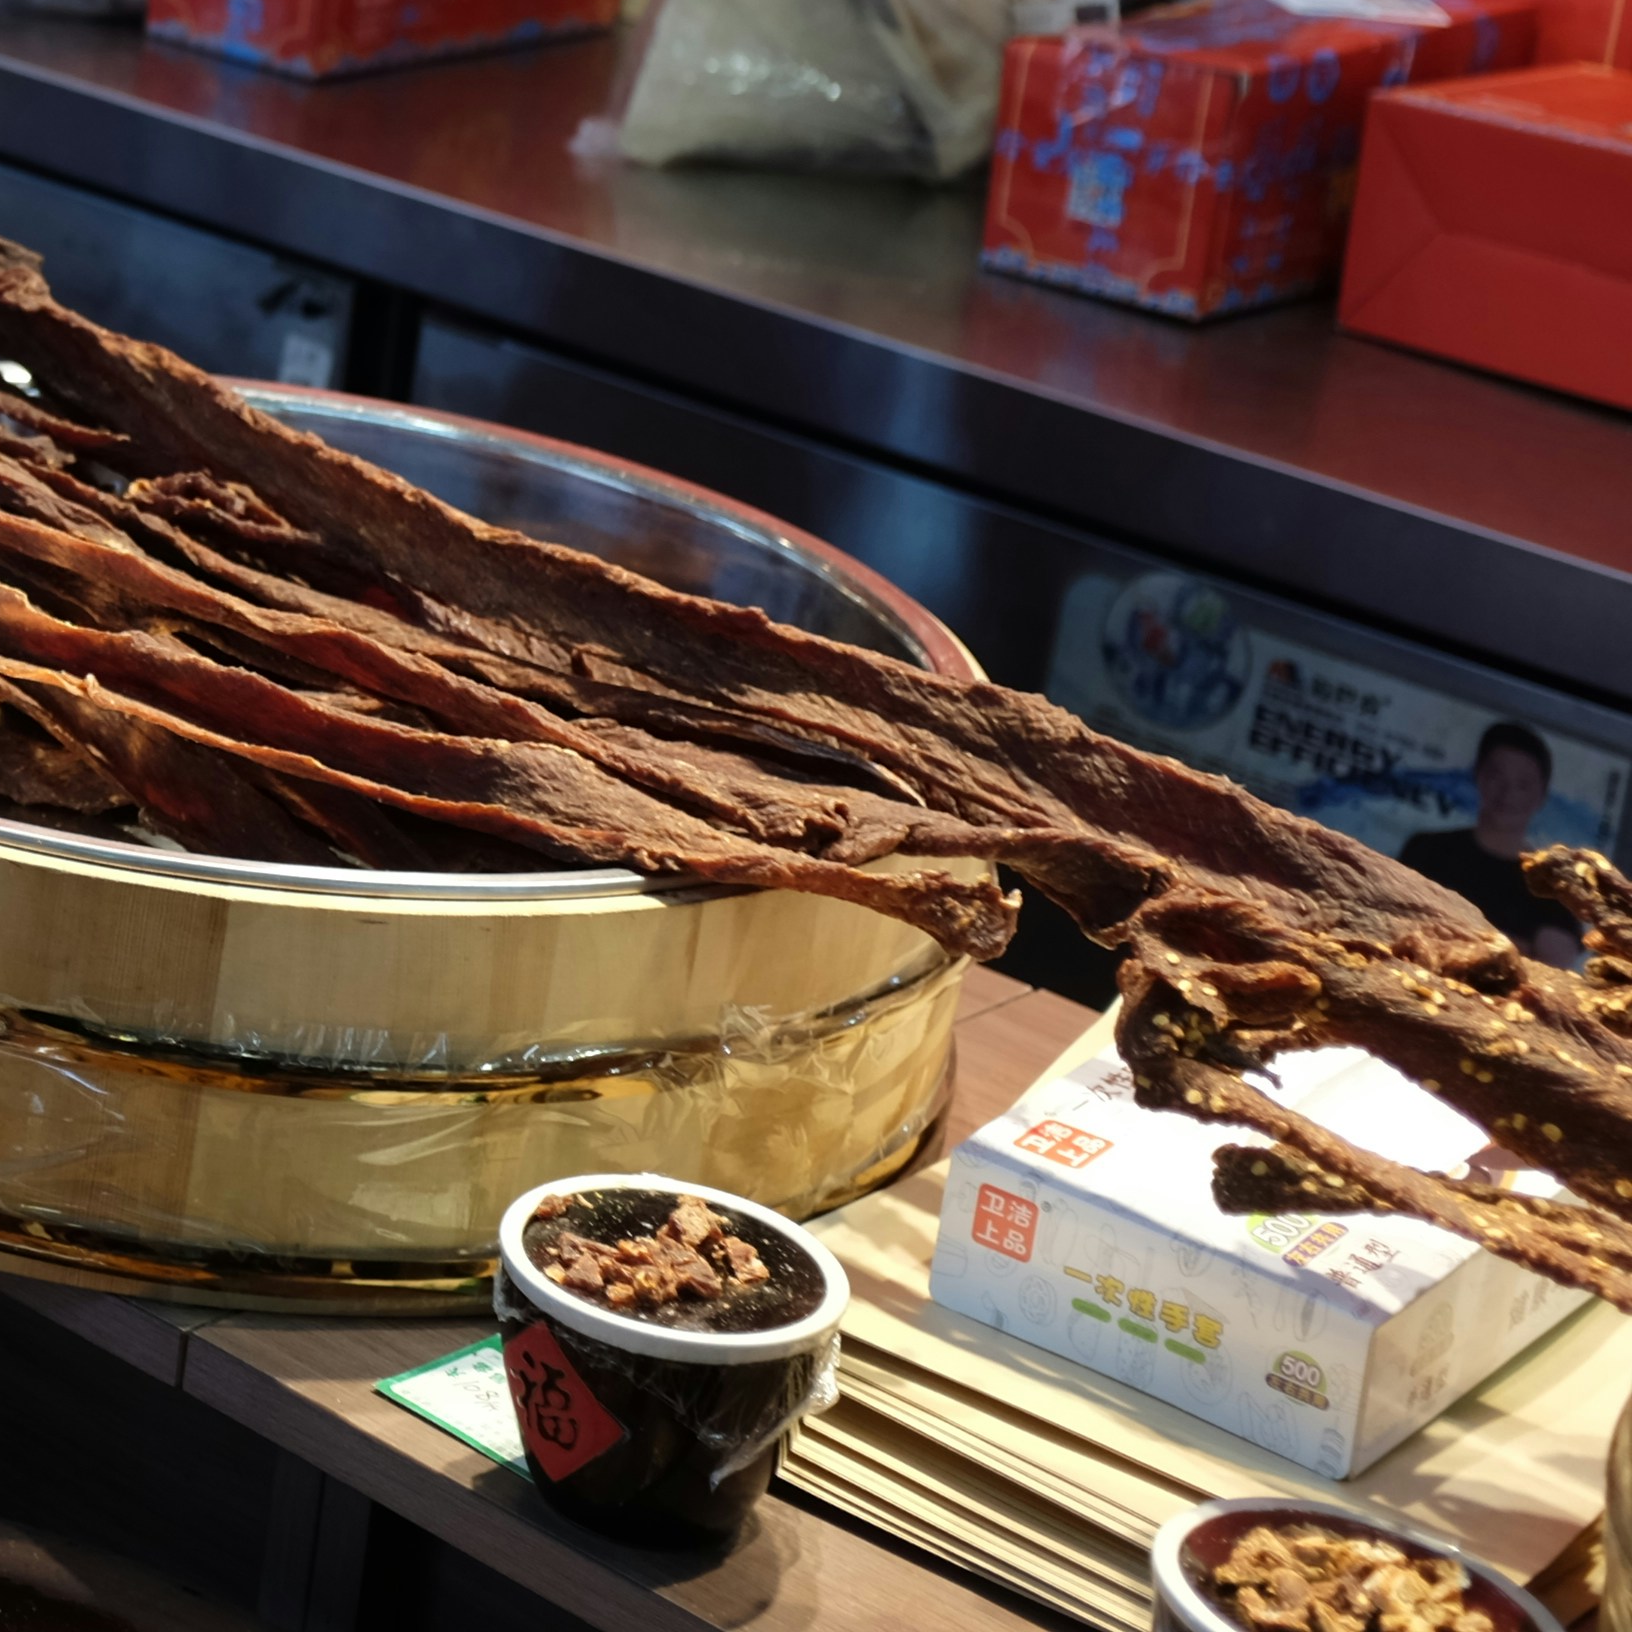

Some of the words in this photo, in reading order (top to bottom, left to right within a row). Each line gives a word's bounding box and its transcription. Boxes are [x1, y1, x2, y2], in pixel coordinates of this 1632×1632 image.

[1020, 1121, 1074, 1156] 卫洁
[1056, 1134, 1107, 1167] 上品
[980, 1189, 1034, 1227] 卫洁
[975, 1218, 1029, 1256] 上品
[1251, 1212, 1311, 1247] 500
[1324, 1238, 1401, 1290] 普通型
[1063, 1265, 1225, 1350] 一次性手套
[1280, 1355, 1322, 1388] 500
